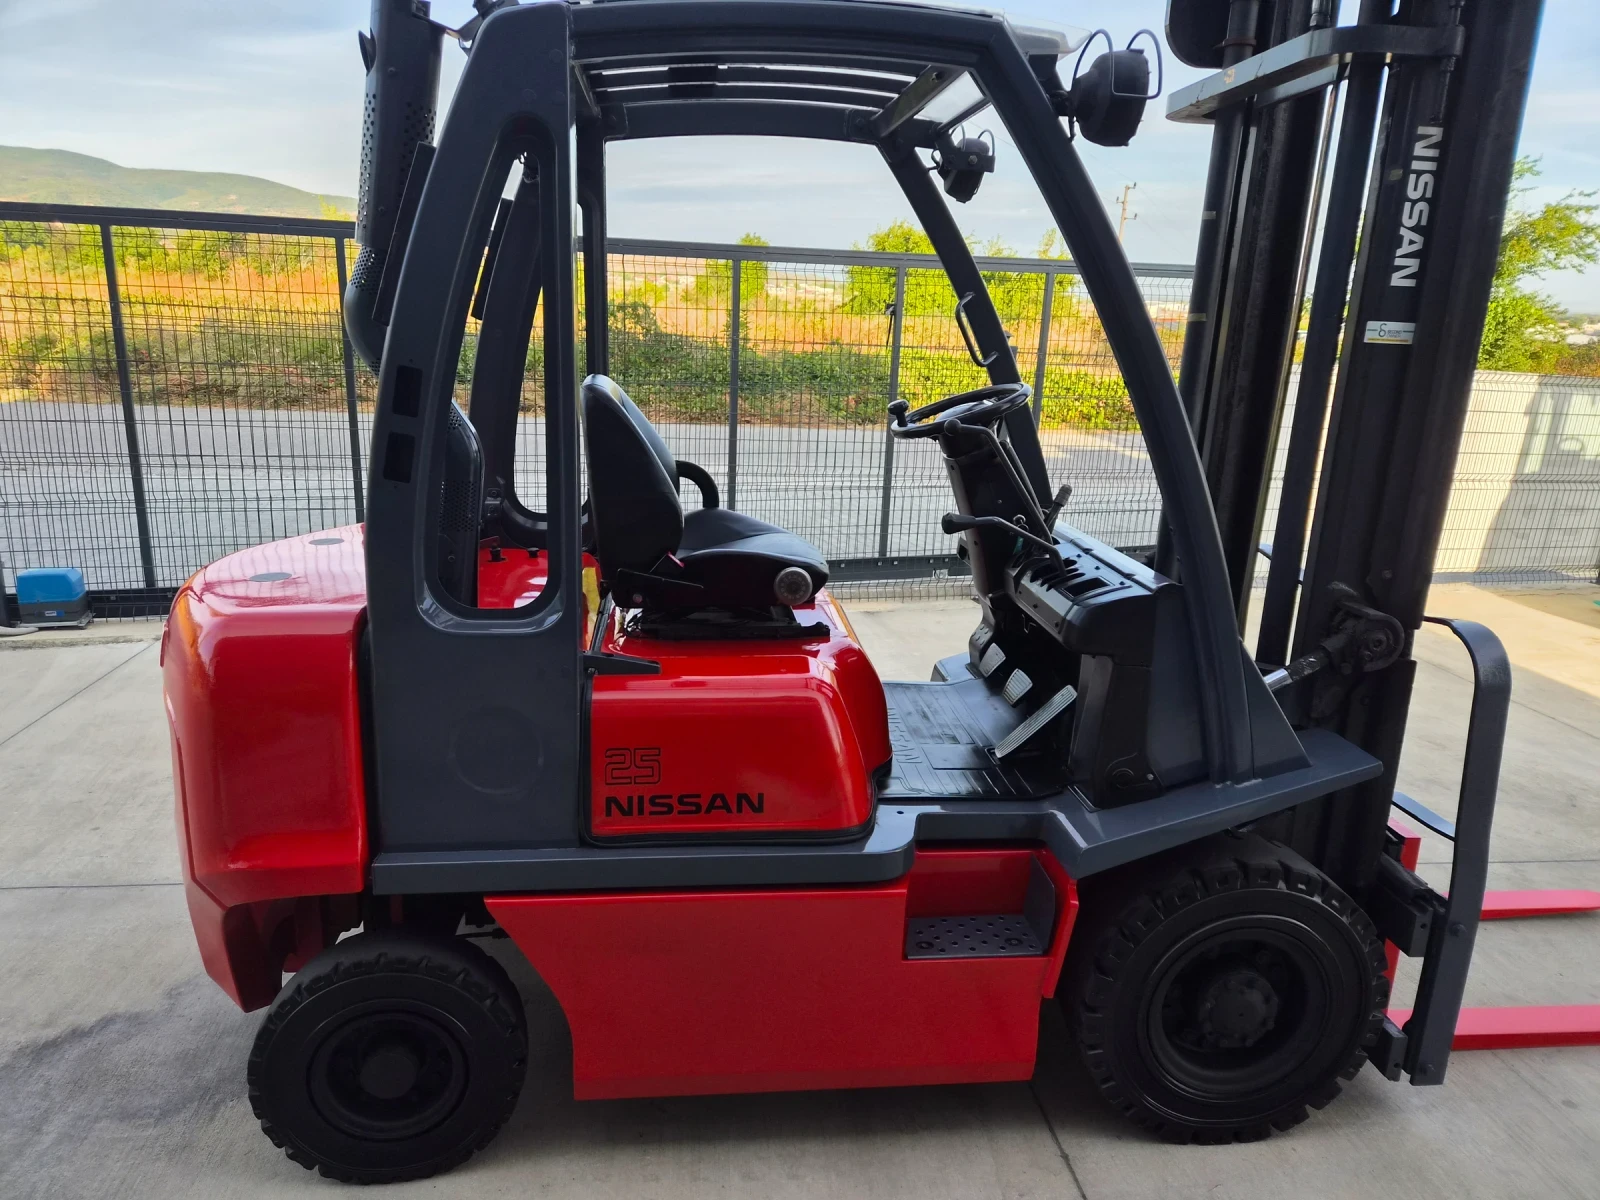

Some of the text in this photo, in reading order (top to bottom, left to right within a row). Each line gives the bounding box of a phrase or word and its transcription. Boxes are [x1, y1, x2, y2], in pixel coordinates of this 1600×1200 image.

[1390, 126, 1444, 287] NISSAN
[605, 747, 661, 785] 25
[605, 793, 764, 817] NISSAN
